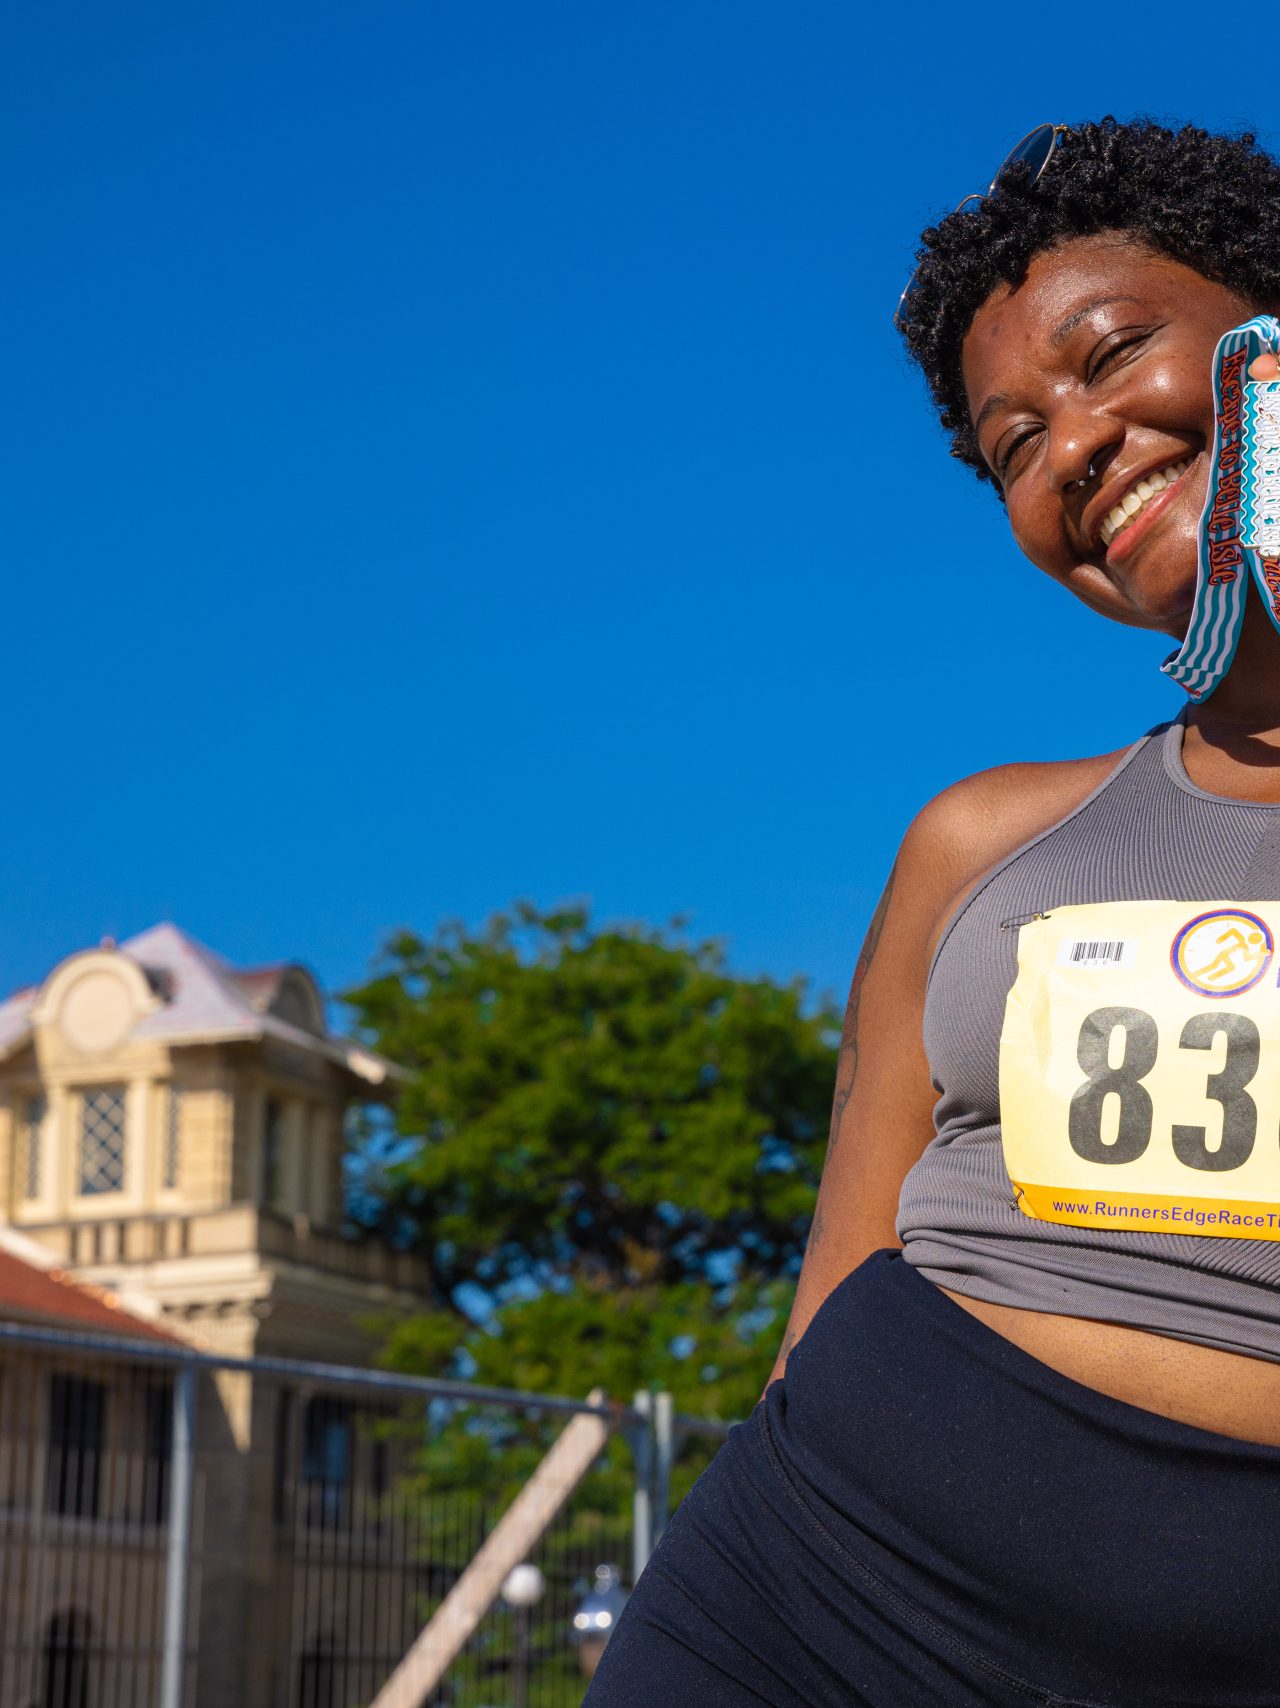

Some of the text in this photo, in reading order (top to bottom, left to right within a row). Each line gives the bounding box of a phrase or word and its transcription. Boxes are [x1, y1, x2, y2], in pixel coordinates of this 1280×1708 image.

[1207, 345, 1248, 587] Escape to Belle Isle
